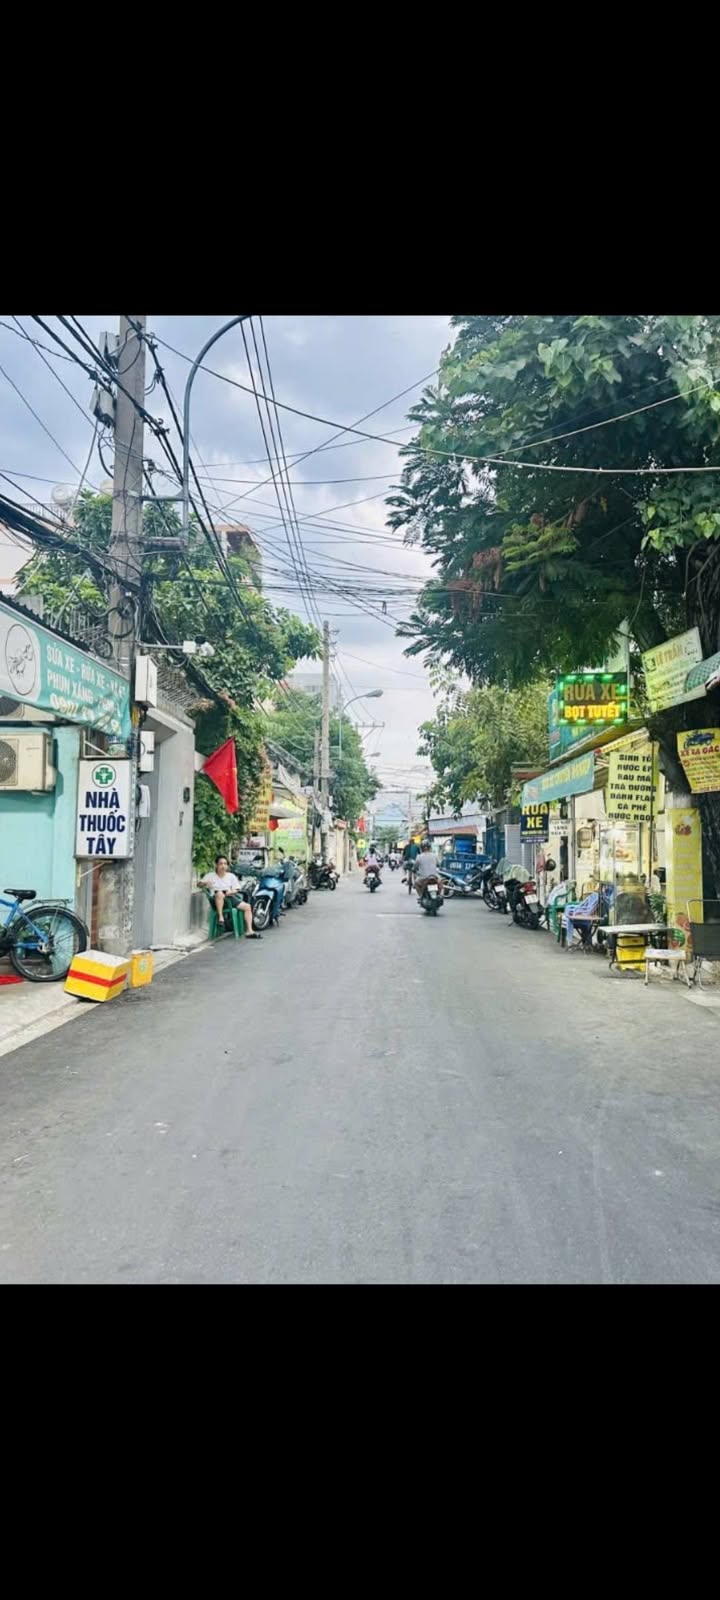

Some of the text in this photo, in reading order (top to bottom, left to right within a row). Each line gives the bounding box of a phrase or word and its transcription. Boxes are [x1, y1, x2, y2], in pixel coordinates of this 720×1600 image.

[47, 642, 63, 667] SỬA
[65, 655, 74, 673] XE
[47, 669, 70, 694] PHUN
[564, 679, 595, 701] RỬA
[564, 704, 585, 720] BỌT
[587, 701, 620, 718] TUYẾT
[617, 764, 640, 772] NƯỚC
[619, 754, 639, 762] SINH
[85, 787, 120, 808] NHÀ
[79, 809, 125, 832] THUỐC
[527, 816, 543, 829] XE
[86, 834, 116, 855] TÂY
